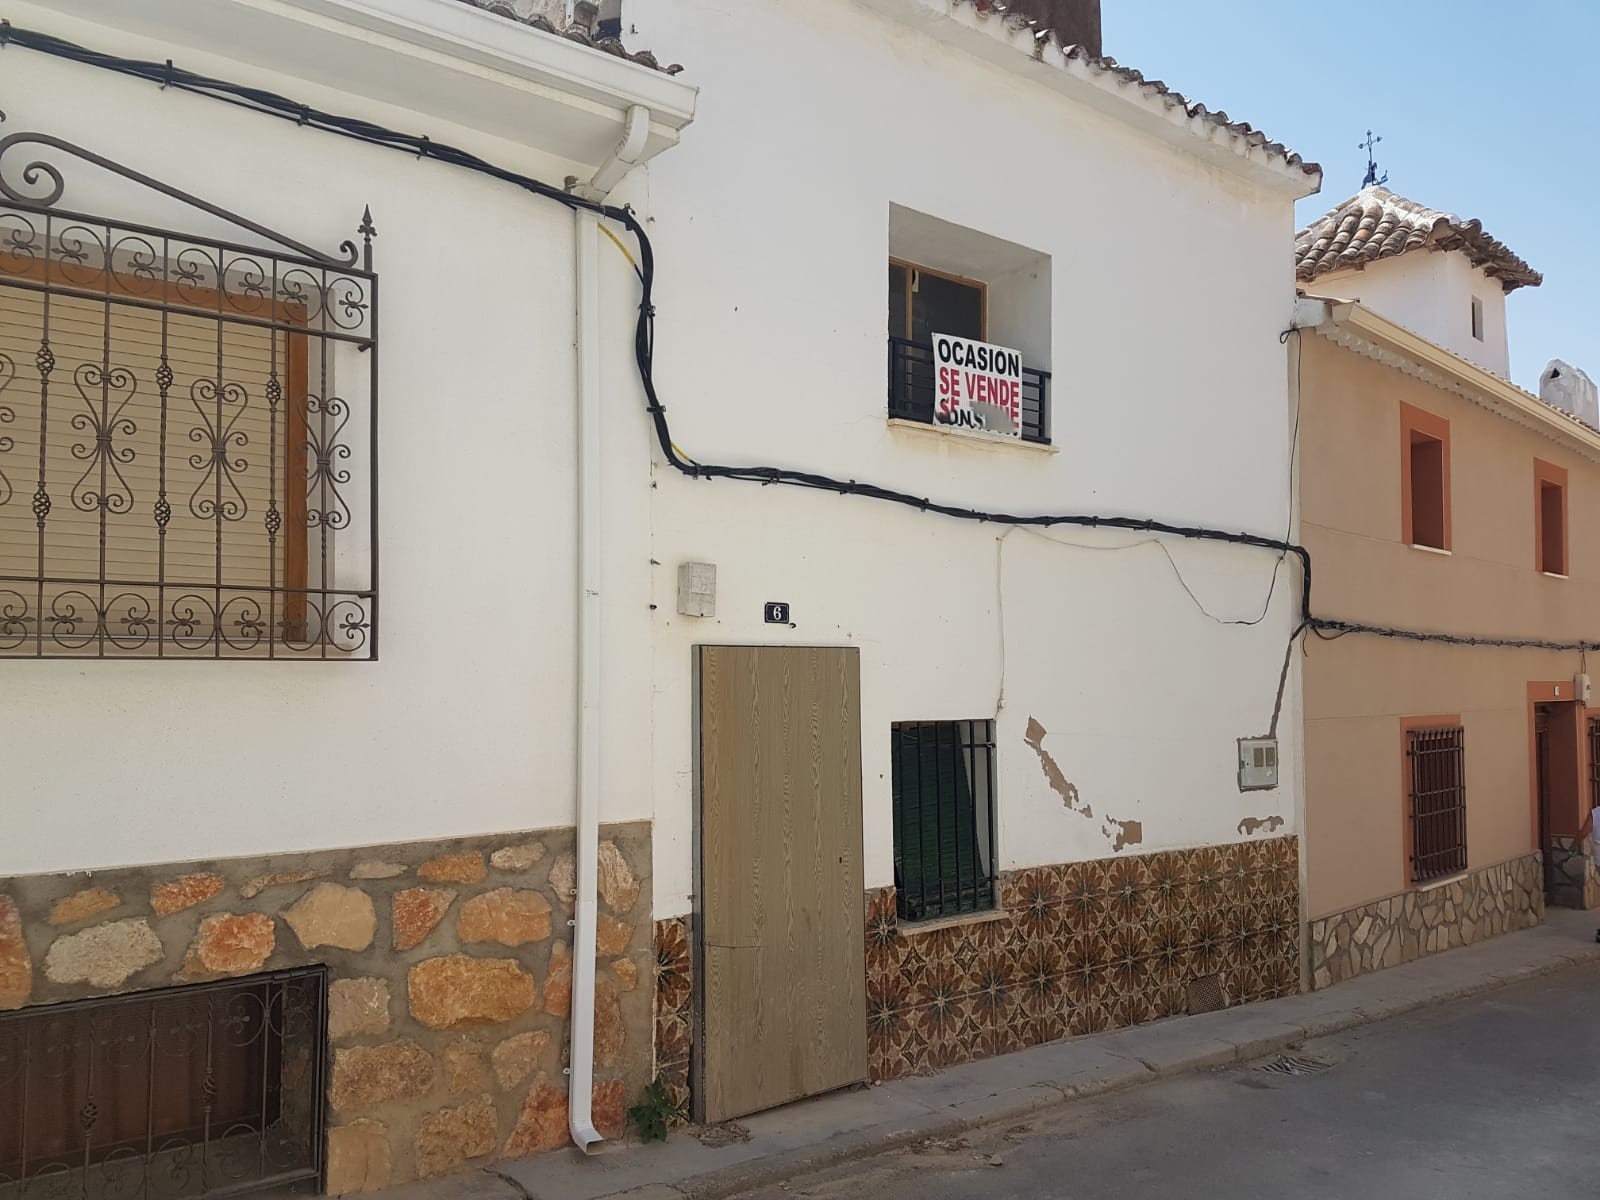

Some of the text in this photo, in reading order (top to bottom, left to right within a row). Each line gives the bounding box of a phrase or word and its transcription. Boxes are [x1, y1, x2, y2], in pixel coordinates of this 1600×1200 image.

[938, 338, 1019, 377] OCASION
[940, 366, 1020, 408] SE VENDE
[773, 605, 782, 620] 6
